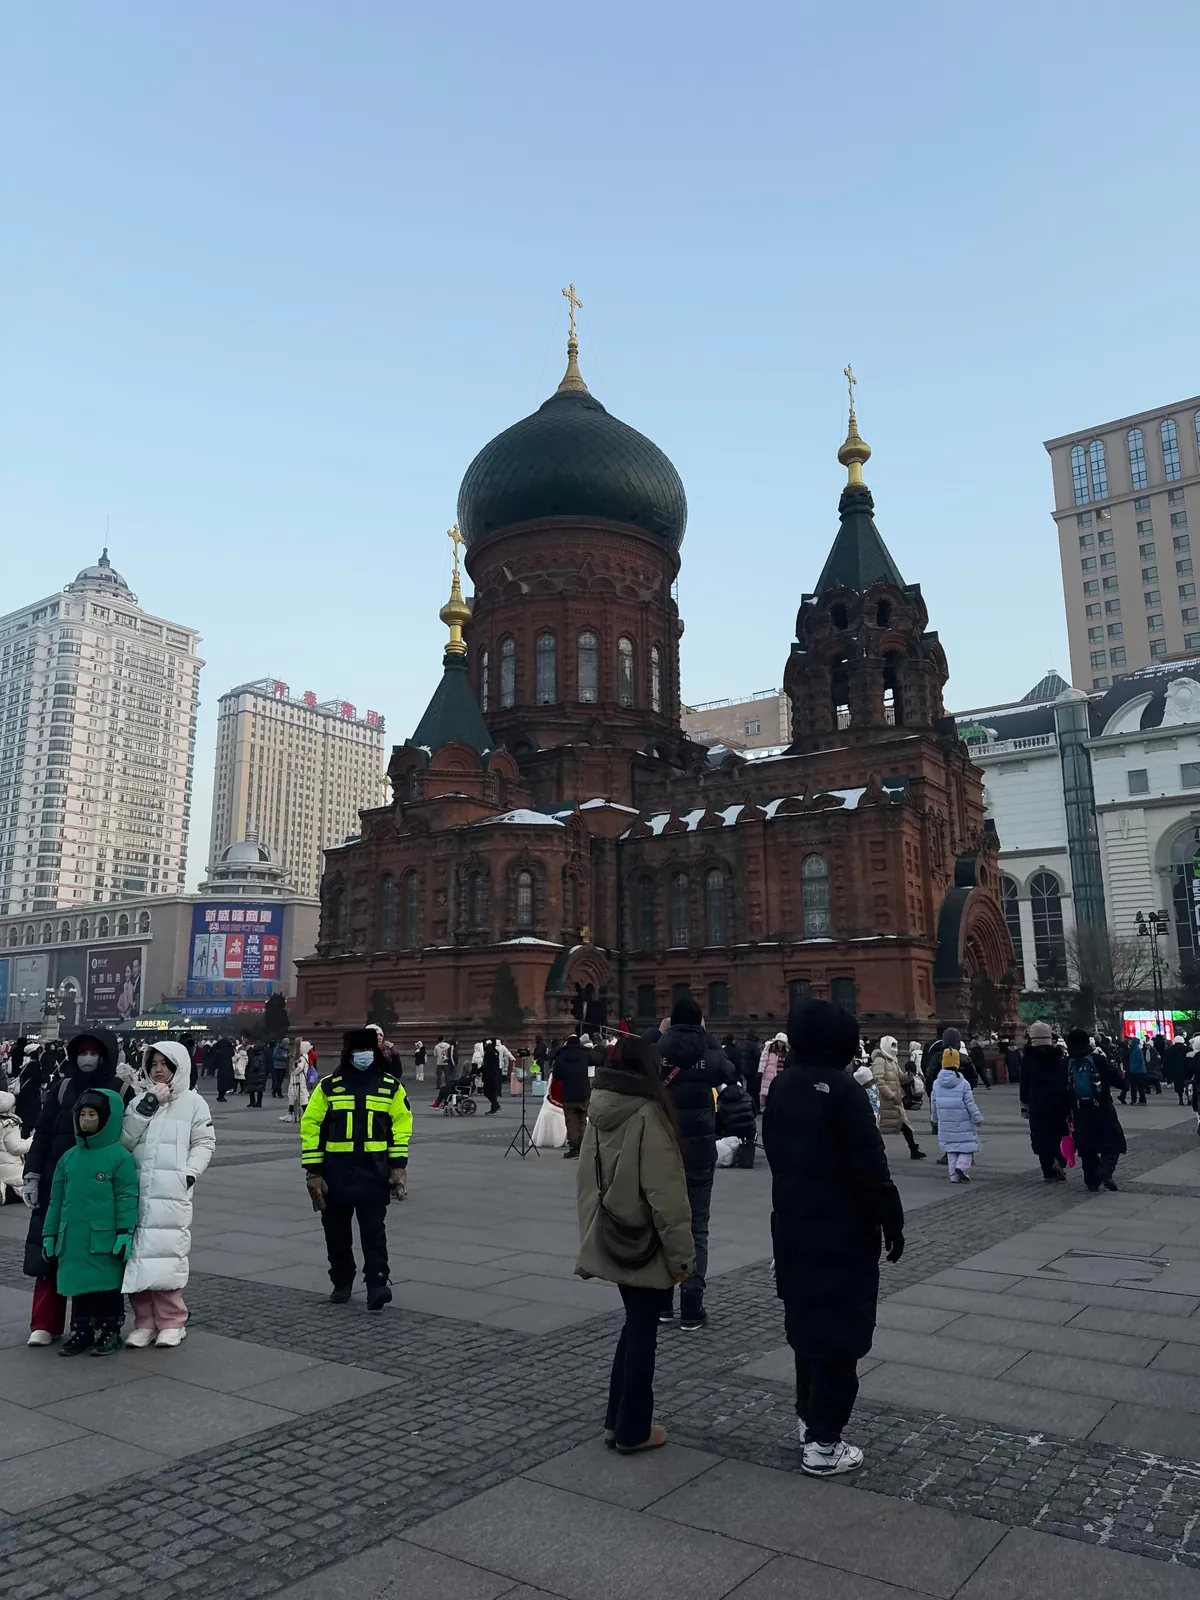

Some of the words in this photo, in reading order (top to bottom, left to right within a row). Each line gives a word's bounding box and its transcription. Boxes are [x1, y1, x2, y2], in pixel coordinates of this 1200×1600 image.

[205, 909, 272, 923] 新盛隆商厦
[135, 1020, 169, 1028] BURBERRY
